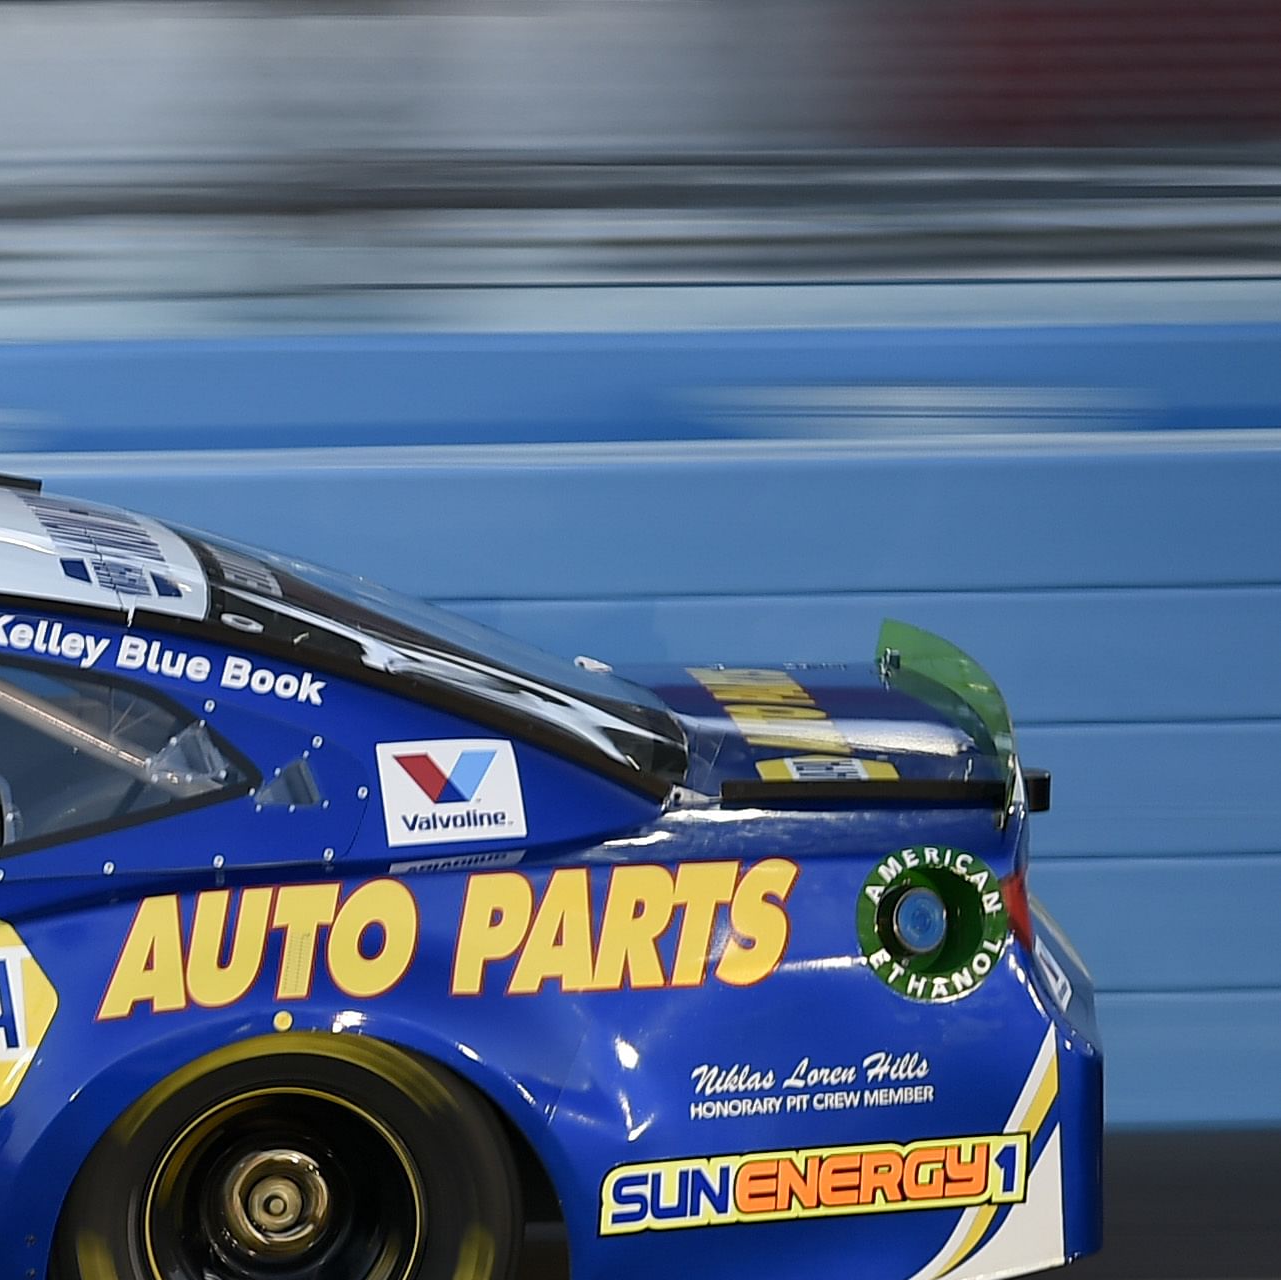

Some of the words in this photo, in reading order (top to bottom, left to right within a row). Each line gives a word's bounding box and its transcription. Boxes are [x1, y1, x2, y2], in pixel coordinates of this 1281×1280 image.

[116, 635, 211, 682] Blue
[220, 655, 326, 705] Book
[402, 810, 506, 831] Valvoline
[866, 847, 1003, 916] AMERICAN
[95, 877, 418, 1021] AUTO
[449, 857, 801, 999] PARTS
[869, 939, 1003, 999] ETHANOL
[690, 1096, 783, 1121] HONORARY
[785, 1094, 810, 1113] PIT
[812, 1090, 861, 1111] CREW
[863, 1086, 935, 1107] MEMBER
[691, 1064, 776, 1096] Niklas
[782, 1057, 856, 1090] Loren
[862, 1051, 930, 1082] Hills
[611, 1142, 1017, 1224] SUNENERGY1
